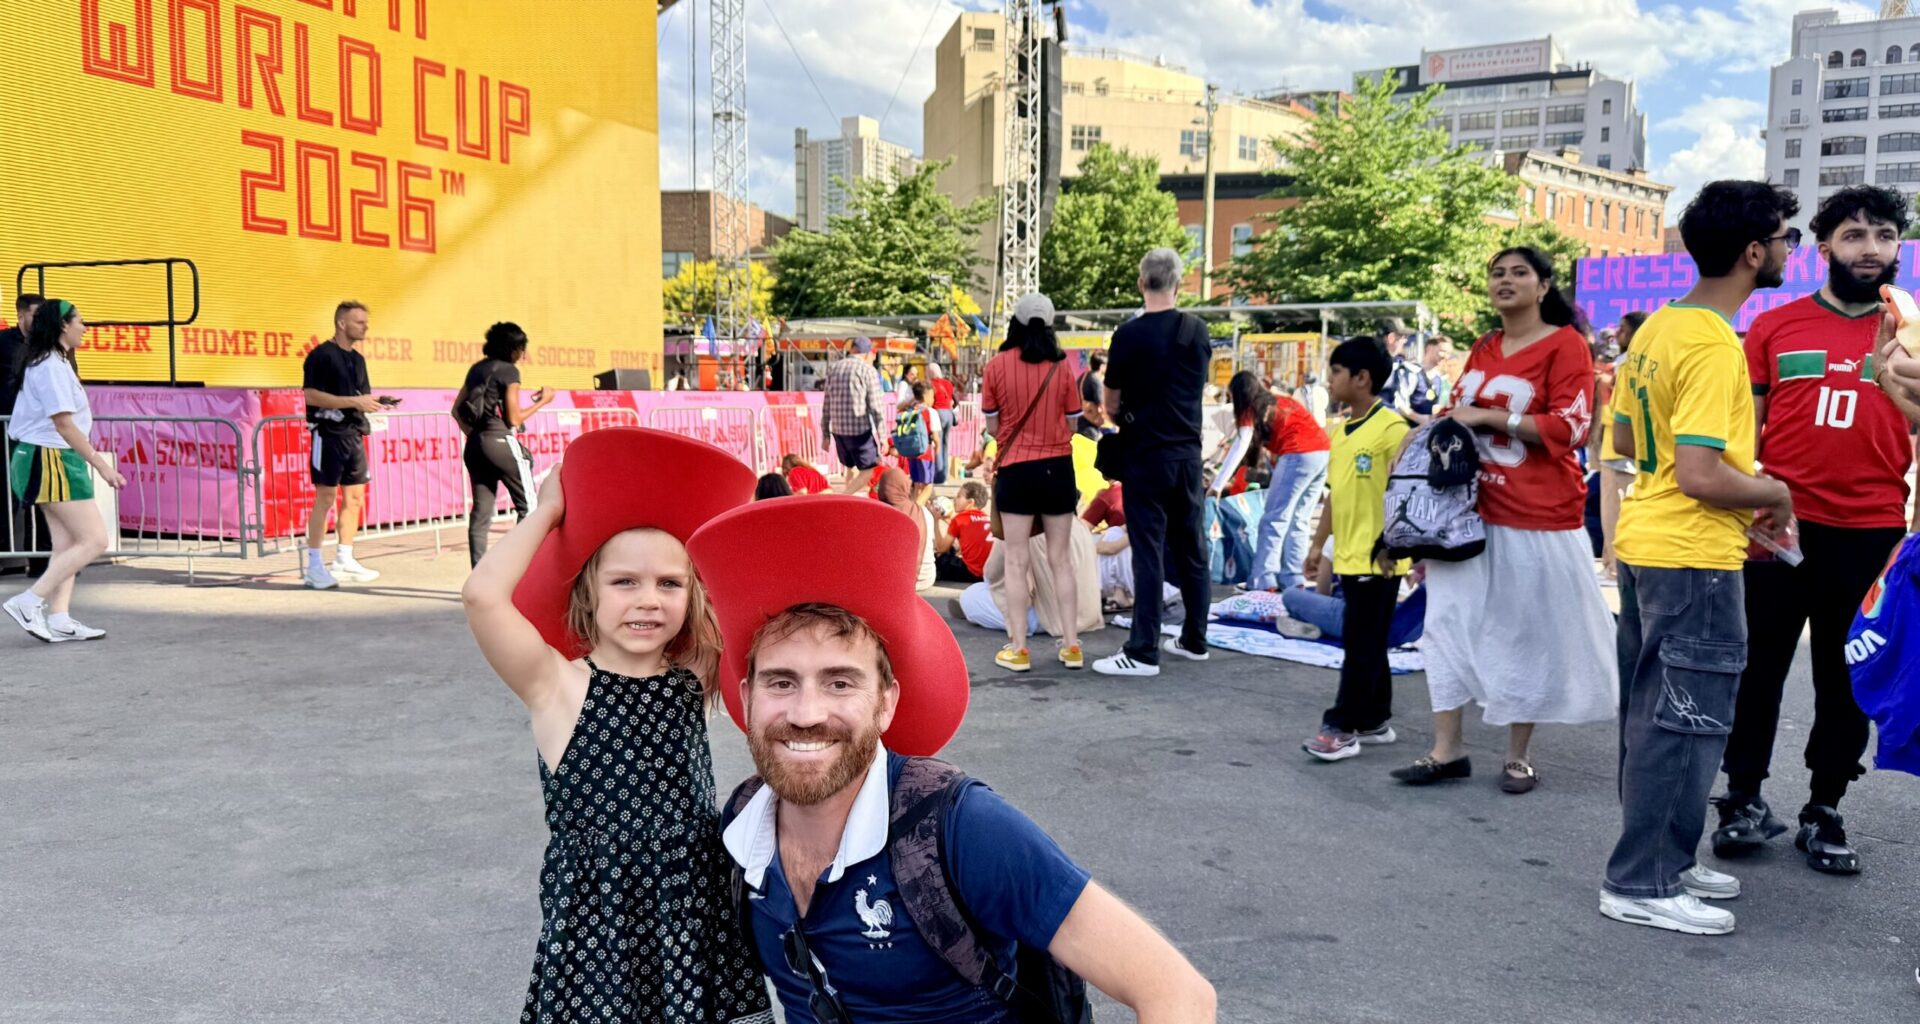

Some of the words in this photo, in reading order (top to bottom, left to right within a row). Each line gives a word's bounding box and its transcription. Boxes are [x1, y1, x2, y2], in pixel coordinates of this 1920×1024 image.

[80, 0, 382, 136] WORLD
[413, 56, 530, 165] CUP
[181, 327, 258, 356] HOME
[264, 331, 293, 357] OF
[537, 346, 596, 368] SOCCER
[1828, 363, 1853, 373] PUMA
[1815, 386, 1858, 429] 10
[156, 439, 238, 473] SOCCE
[382, 437, 443, 463] HOME
